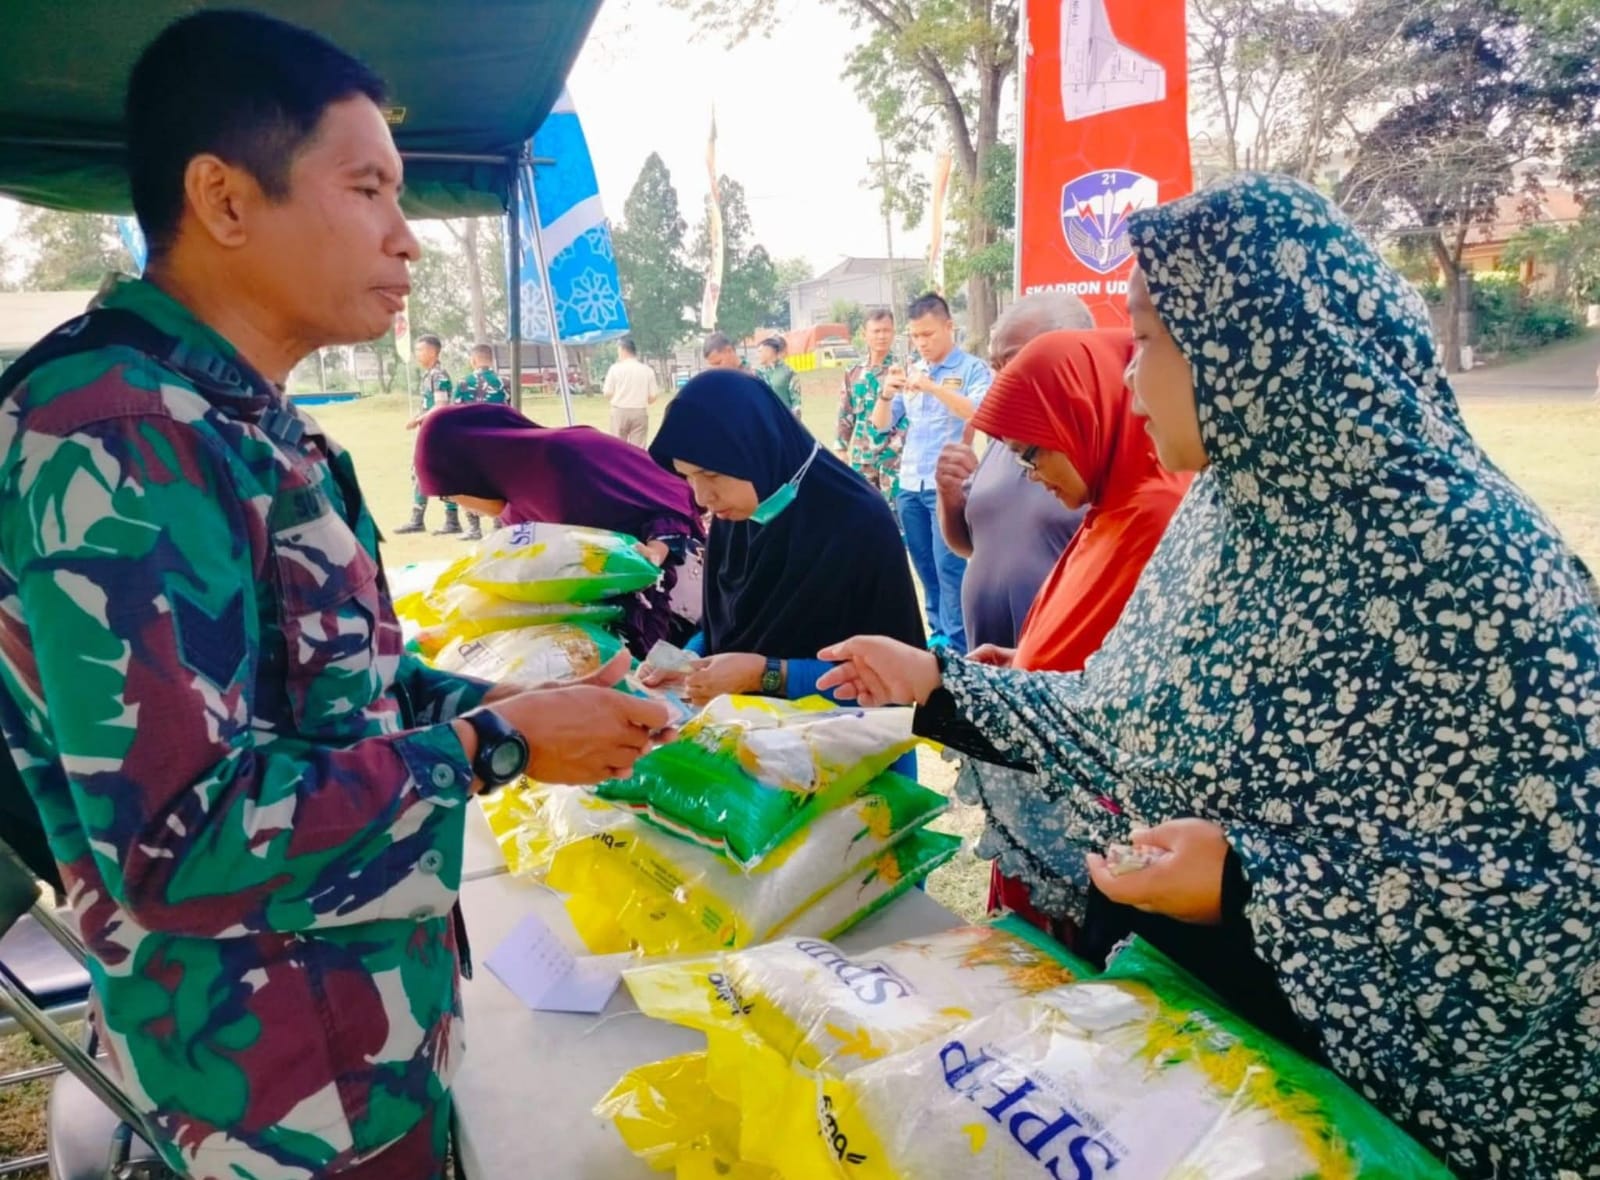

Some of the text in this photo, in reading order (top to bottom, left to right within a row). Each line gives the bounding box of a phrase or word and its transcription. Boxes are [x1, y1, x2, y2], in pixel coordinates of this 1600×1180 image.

[1102, 172, 1116, 185] 21
[1025, 281, 1100, 296] SKADRON
[939, 1041, 1120, 1180] SPHP
